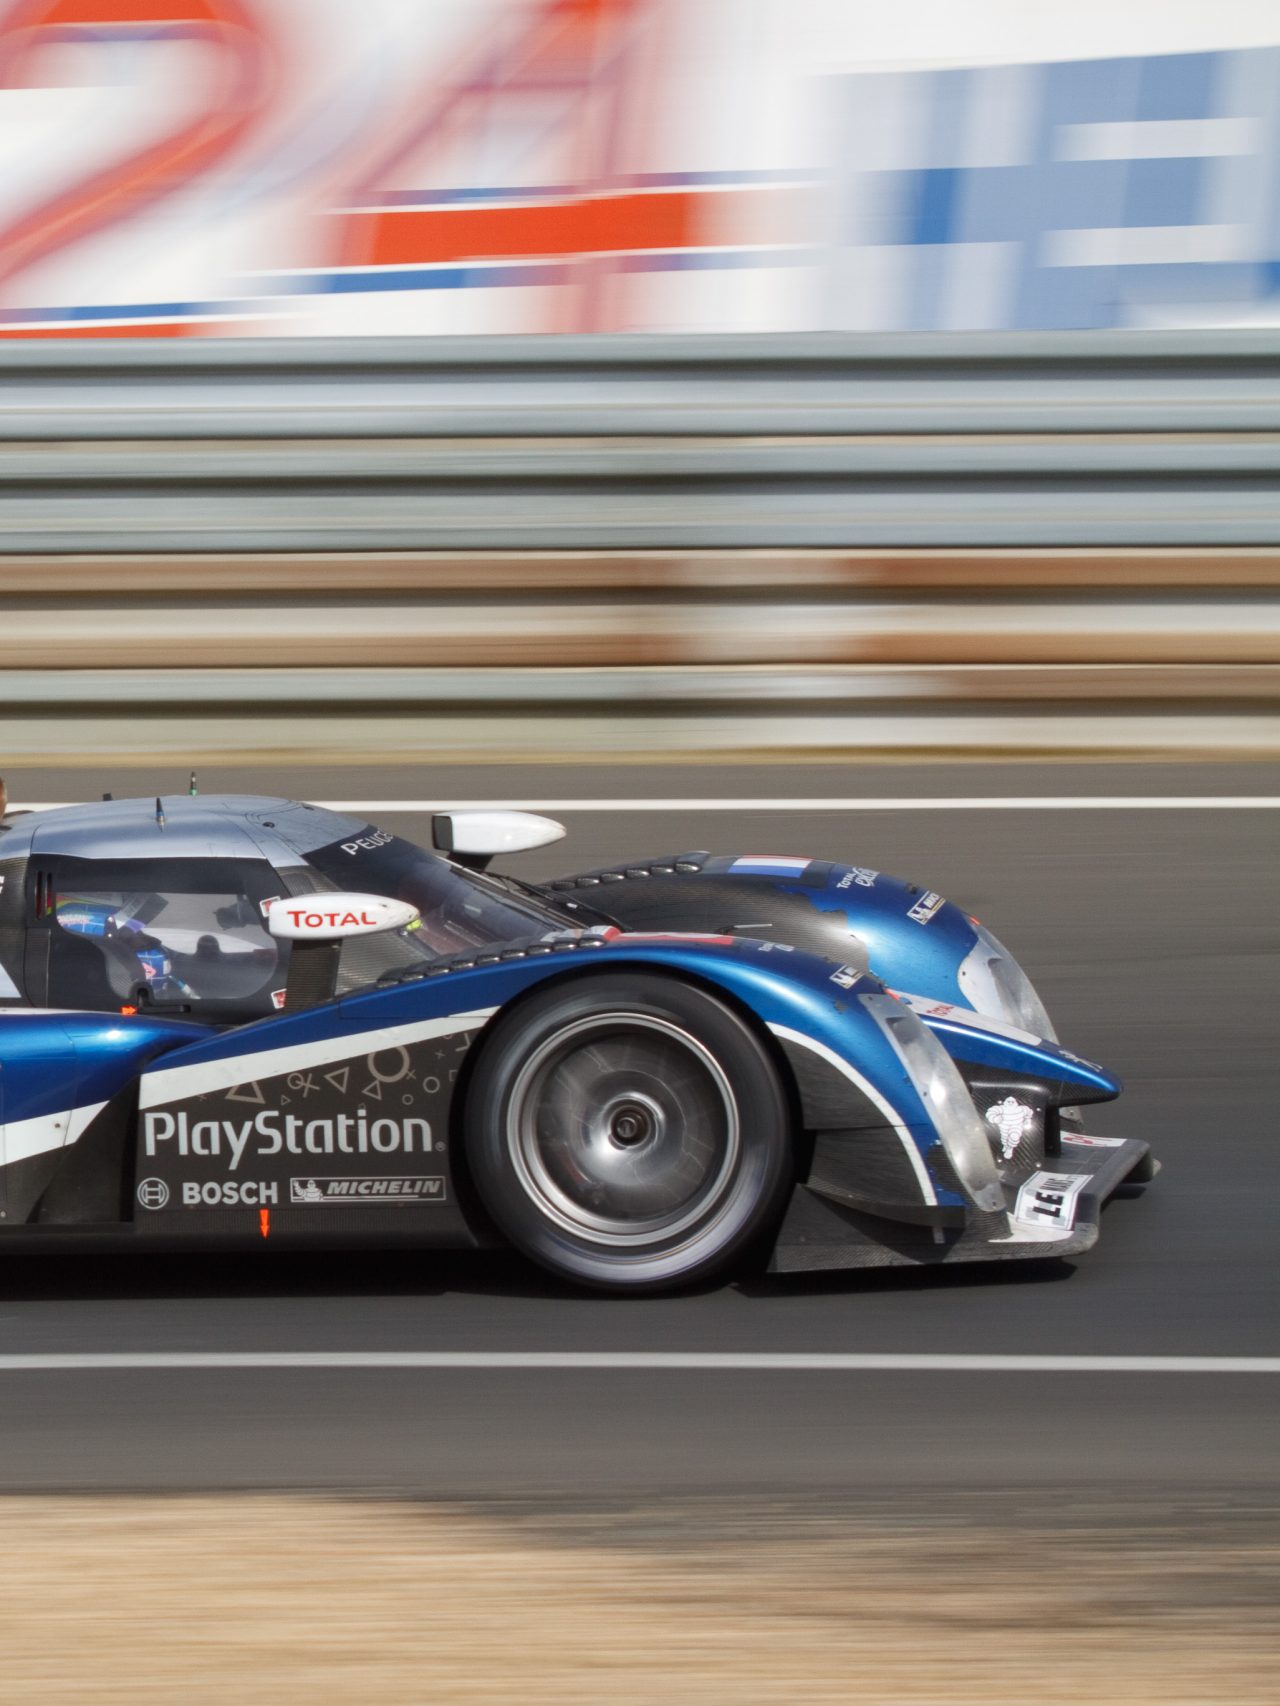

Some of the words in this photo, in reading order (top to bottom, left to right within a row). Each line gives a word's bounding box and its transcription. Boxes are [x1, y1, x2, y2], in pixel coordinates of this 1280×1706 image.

[287, 910, 377, 928] TOTAL
[182, 1181, 278, 1204] BOSCH
[326, 1180, 441, 1194] MICHELIN
[1032, 1191, 1064, 1218] LE
